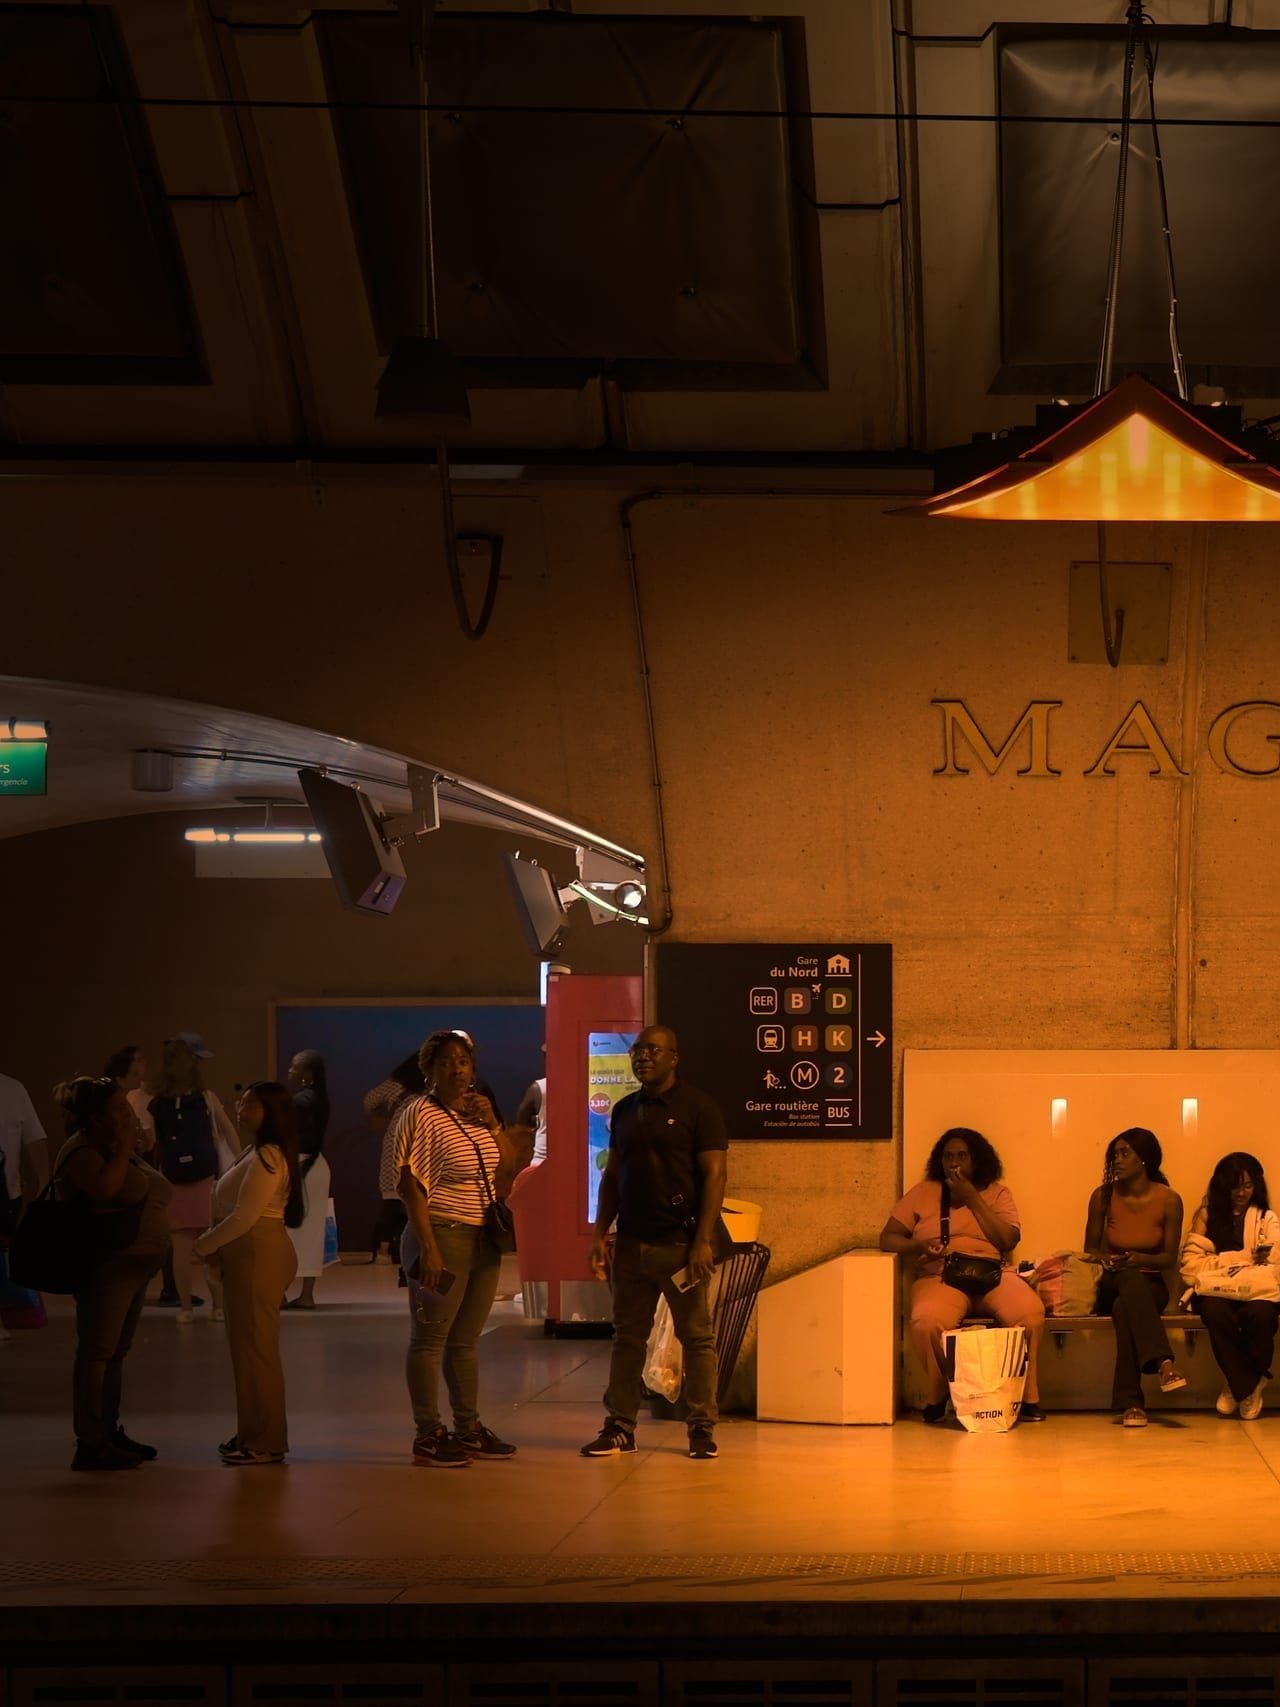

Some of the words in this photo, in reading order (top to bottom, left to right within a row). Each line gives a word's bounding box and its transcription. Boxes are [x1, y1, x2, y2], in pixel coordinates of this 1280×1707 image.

[796, 956, 819, 966] Gare
[770, 966, 786, 978] du
[788, 966, 819, 978] Nord
[753, 995, 774, 1007] RER
[791, 993, 805, 1009] B
[832, 993, 847, 1009] D
[797, 1030, 812, 1047] H
[832, 1030, 846, 1047] K
[797, 1067, 813, 1084] M
[832, 1066, 846, 1084] 2
[745, 1100, 772, 1111] Gare
[774, 1100, 819, 1111] routière
[827, 1106, 850, 1118] BUS
[975, 1409, 1003, 1420] ACTION
